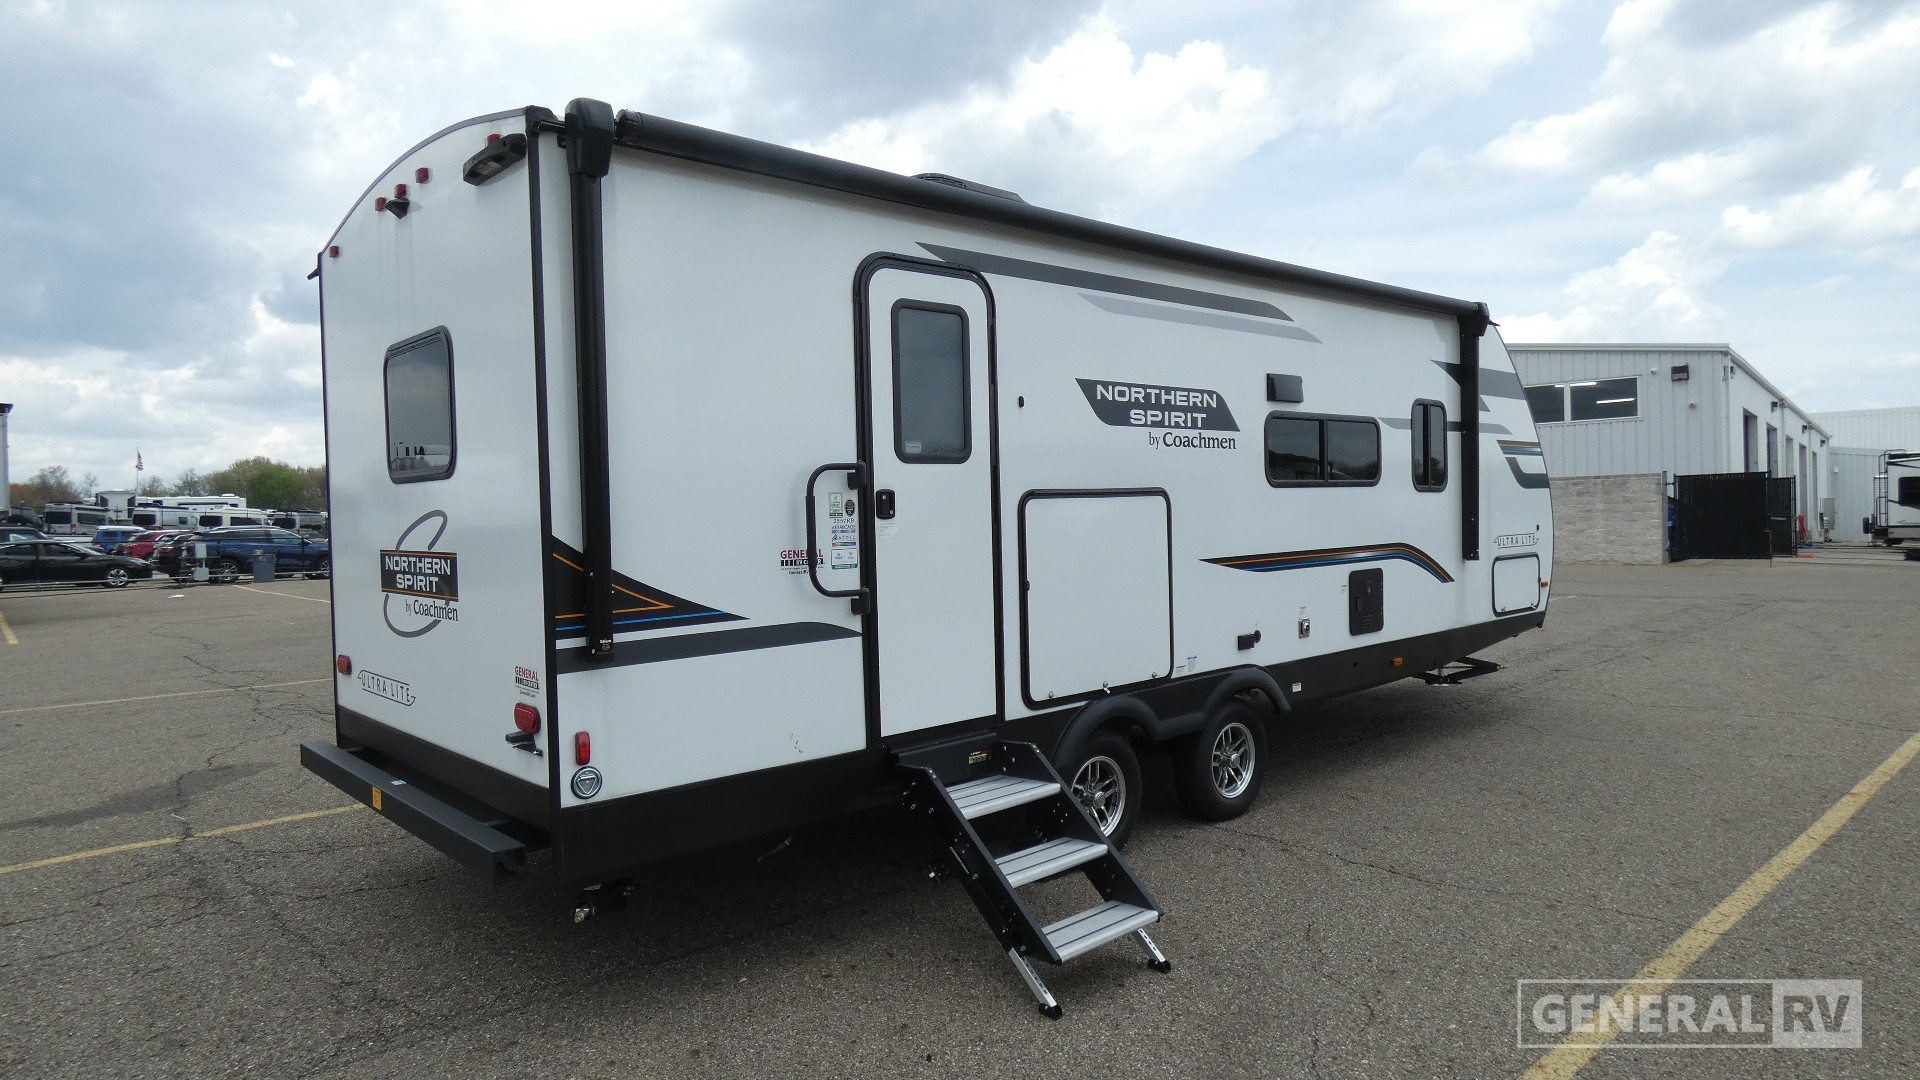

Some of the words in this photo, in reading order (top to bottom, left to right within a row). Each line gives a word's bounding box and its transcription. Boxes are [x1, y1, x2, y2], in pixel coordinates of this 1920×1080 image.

[1096, 384, 1217, 408] NORTHERN
[1129, 409, 1207, 428] SPIRIT
[1148, 432, 1160, 450] by
[1163, 432, 1237, 450] Coachmen
[1497, 536, 1519, 547] ULTRA
[1521, 535, 1536, 545] LITE
[780, 549, 824, 559] GENEL
[385, 555, 451, 576] NORTHERN
[396, 574, 439, 593] SPIRIT
[405, 599, 412, 616] by
[413, 600, 459, 622] Coachmen
[514, 665, 539, 681] GENERAL
[361, 672, 388, 695] ULTRA
[390, 683, 411, 703] LITE
